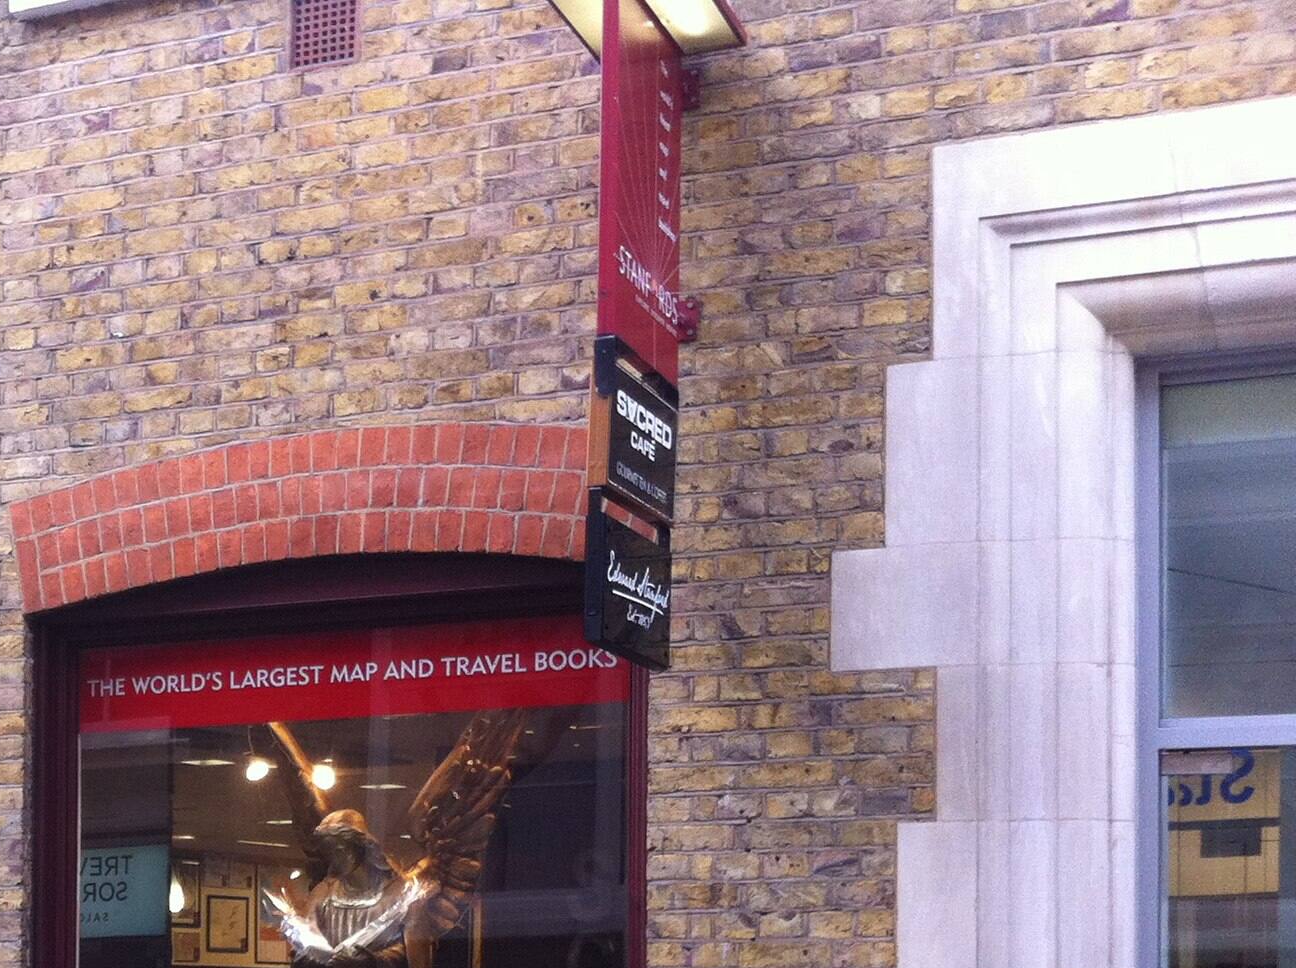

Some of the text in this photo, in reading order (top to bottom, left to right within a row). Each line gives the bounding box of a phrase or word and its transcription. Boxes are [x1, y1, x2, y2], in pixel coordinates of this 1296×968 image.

[616, 389, 672, 450] SACRED
[87, 648, 618, 698] THE WORLD'S LARGEST MAP AND TRAVEL BOOKS
